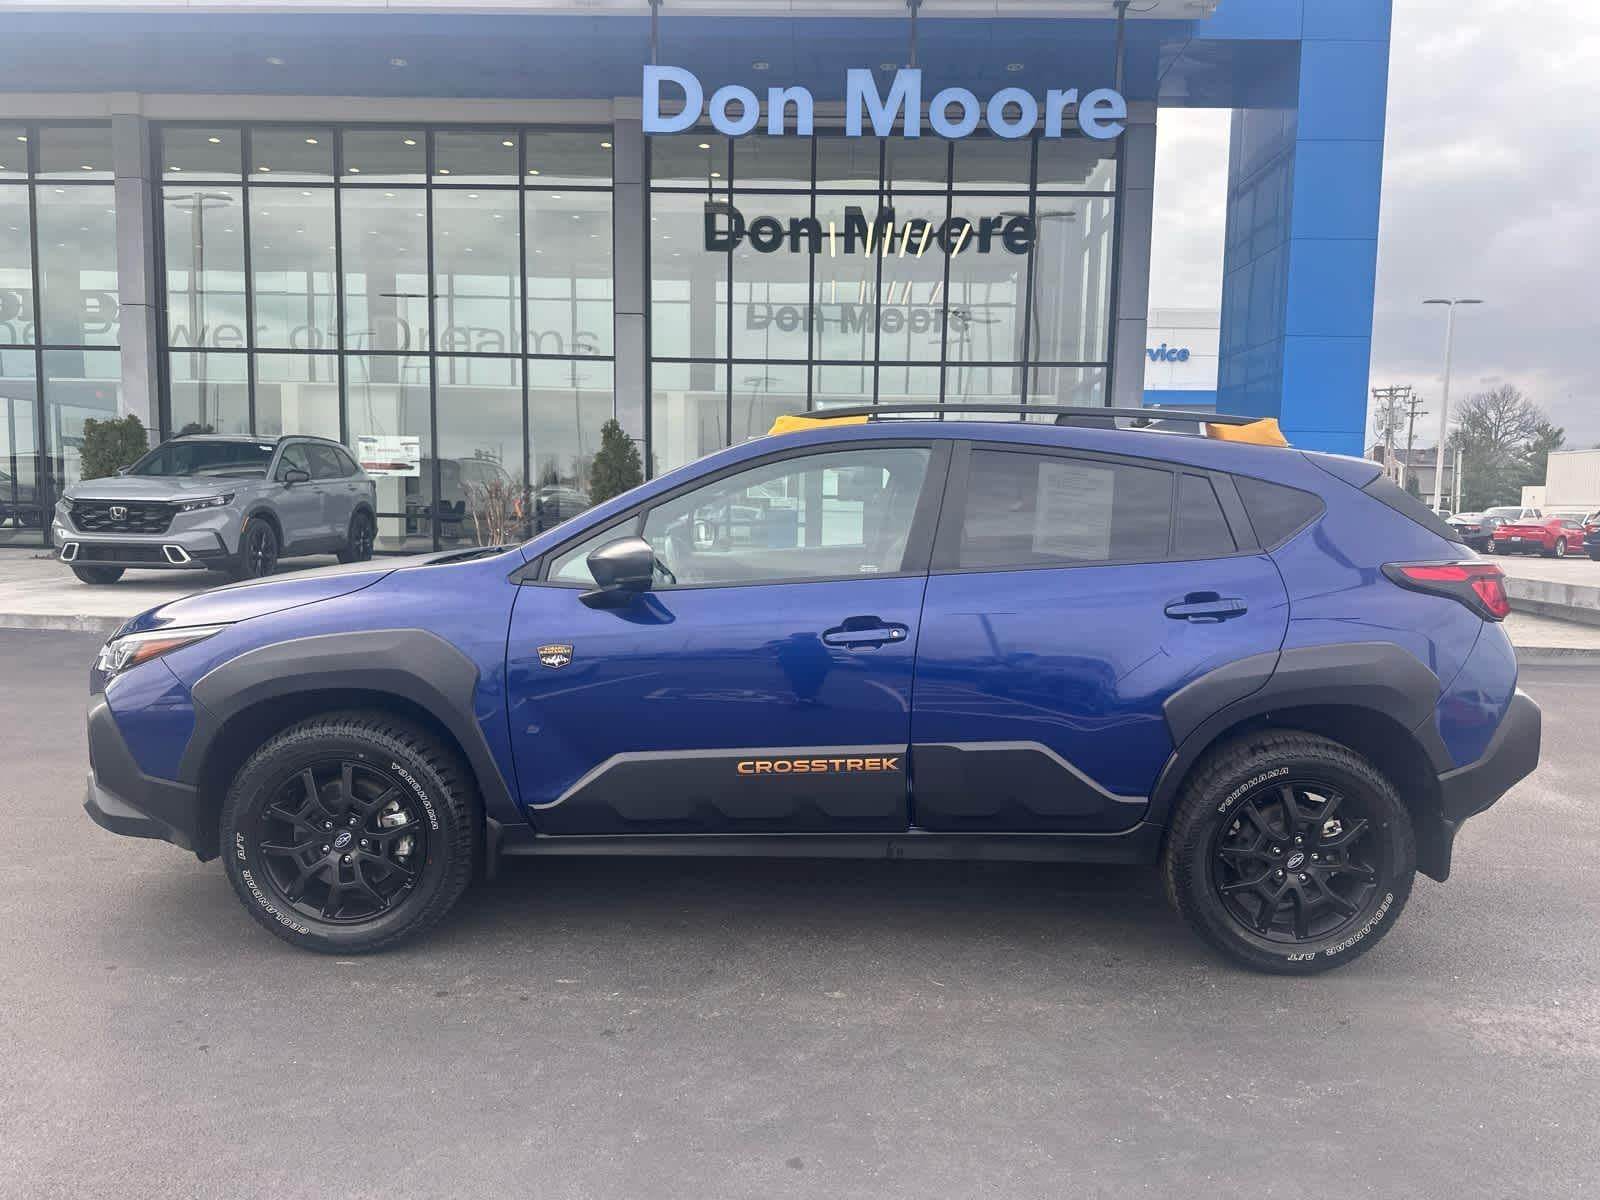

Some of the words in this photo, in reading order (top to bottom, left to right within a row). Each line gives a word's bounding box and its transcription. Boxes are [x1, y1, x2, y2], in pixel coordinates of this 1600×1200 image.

[643, 65, 814, 137] Don
[846, 68, 1128, 140] Moore
[704, 200, 823, 254] Don
[844, 205, 1035, 255] Moore
[81, 316, 267, 347] Pwer
[745, 302, 826, 333] Don
[1146, 343, 1190, 362] vice
[736, 757, 900, 775] CROSSTREK
[391, 762, 439, 831] YOKOHAMA
[1218, 767, 1289, 813] YOKOHAMA
[236, 832, 247, 860] A/T
[242, 868, 310, 935] GEOLANDAR
[1326, 892, 1394, 956] GEOLANDAR
[1287, 952, 1315, 961] A/T
